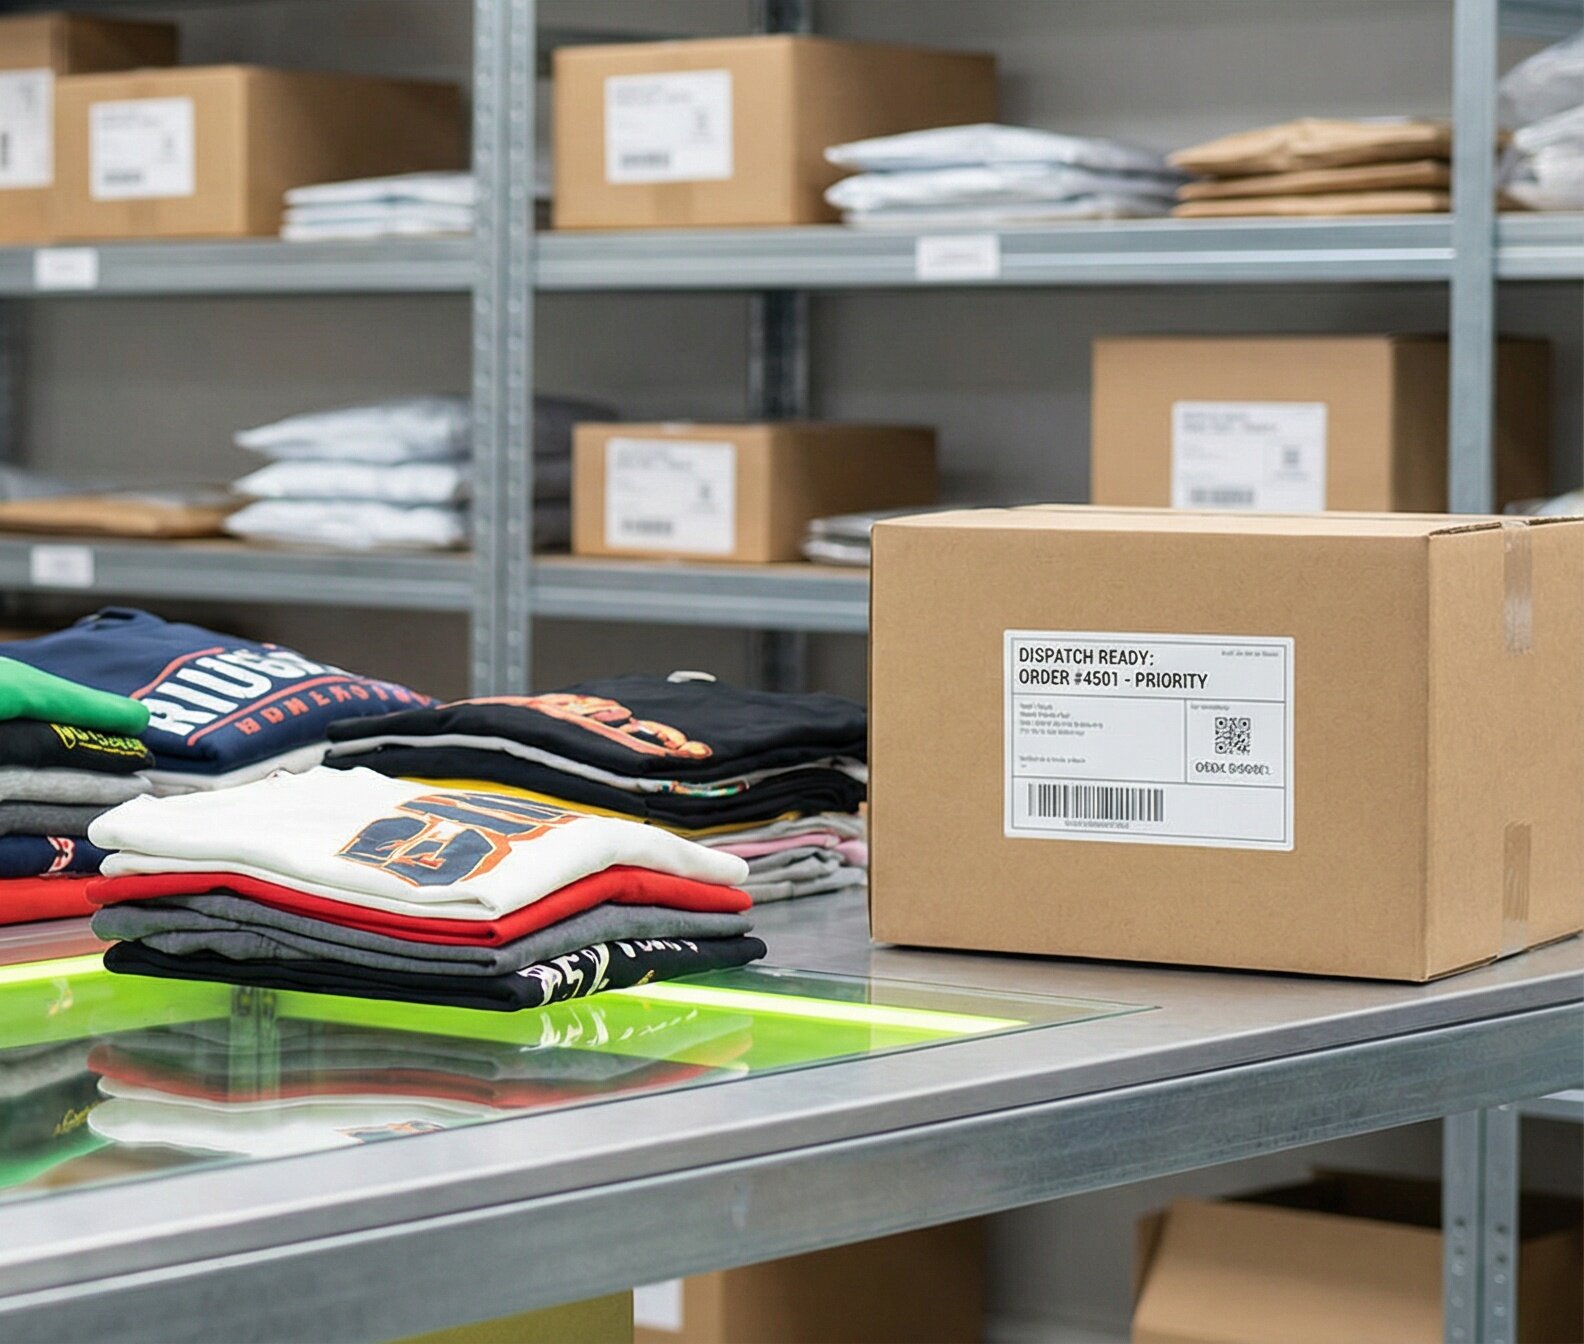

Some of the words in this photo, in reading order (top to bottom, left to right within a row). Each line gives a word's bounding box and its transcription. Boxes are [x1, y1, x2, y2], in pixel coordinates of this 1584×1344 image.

[1019, 647, 1094, 664] DISPATCH
[1098, 649, 1155, 667] READY:
[1018, 668, 1070, 686] ORDER
[1074, 670, 1119, 687] #4501
[1135, 672, 1208, 690] PRIORITY
